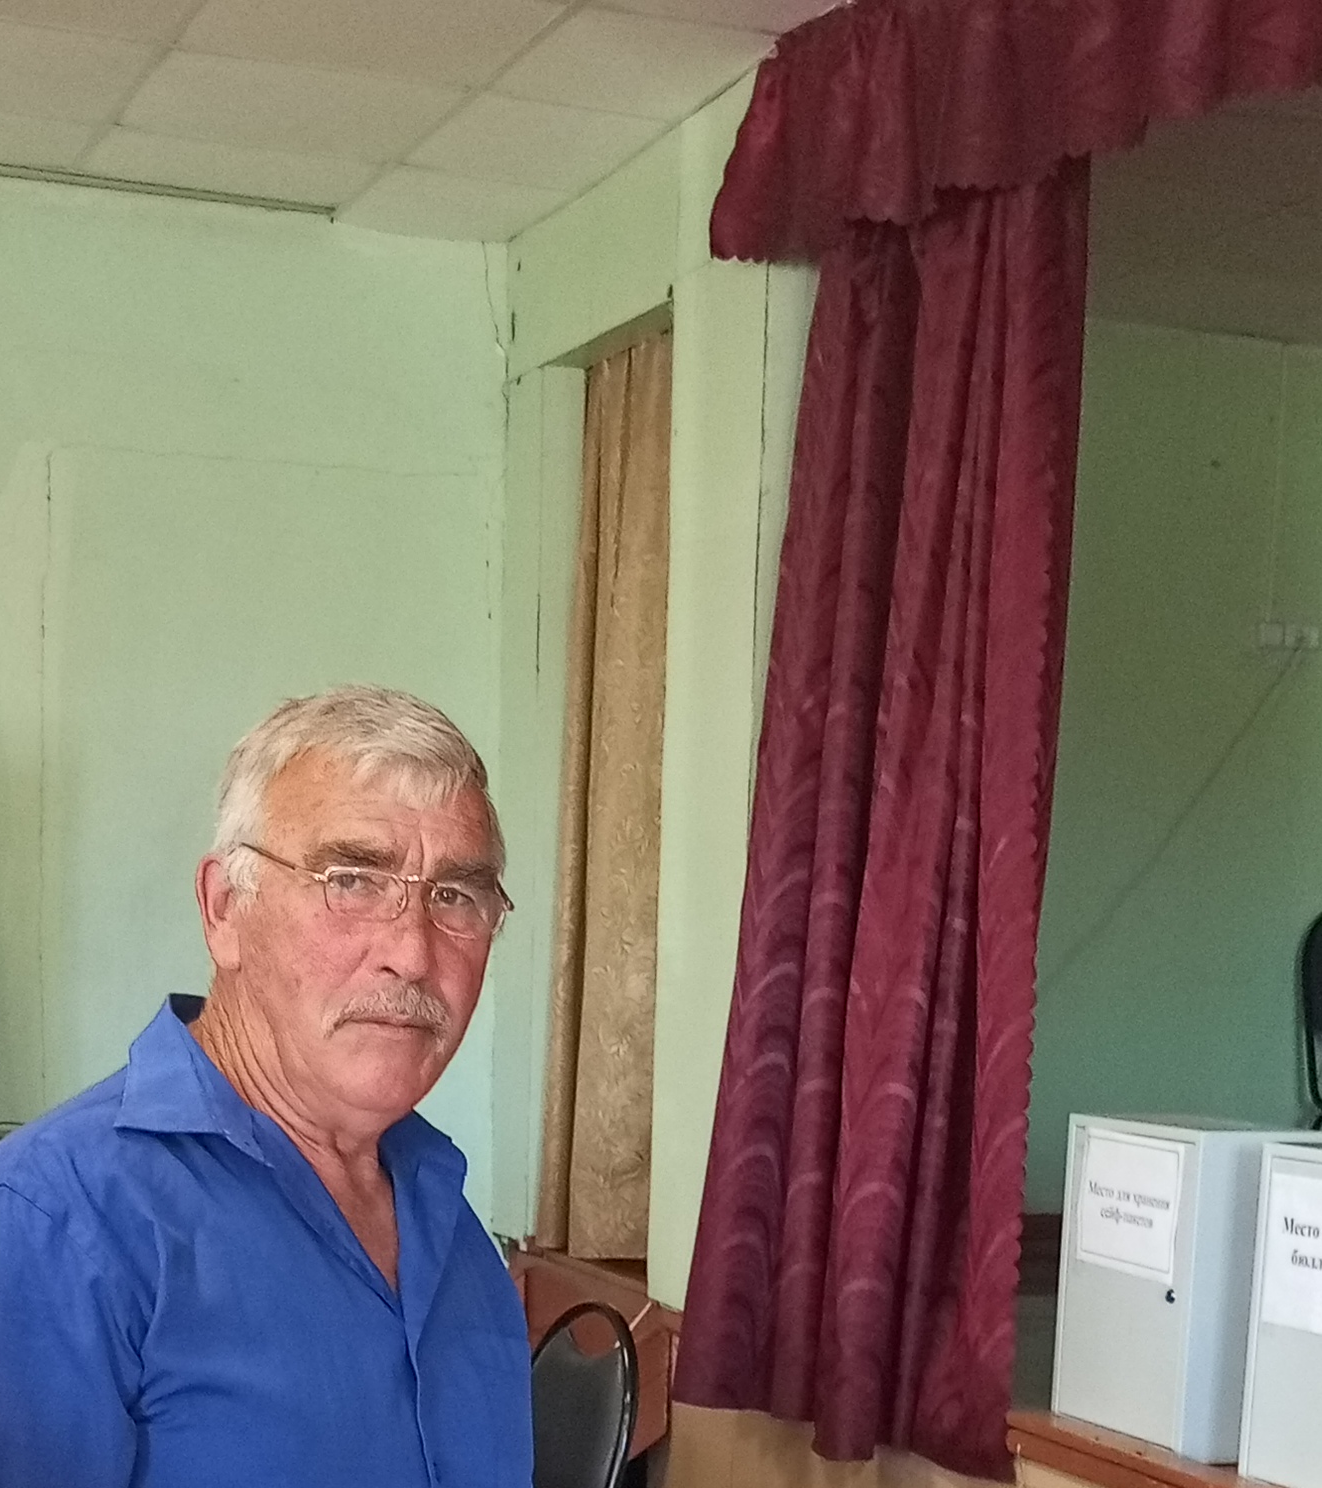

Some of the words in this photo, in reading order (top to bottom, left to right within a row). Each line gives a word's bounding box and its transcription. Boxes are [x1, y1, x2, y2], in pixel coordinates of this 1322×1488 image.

[1088, 1179, 1114, 1198] Место
[1116, 1190, 1131, 1202] для
[1133, 1193, 1171, 1210] хранения
[1283, 1215, 1320, 1239] Место
